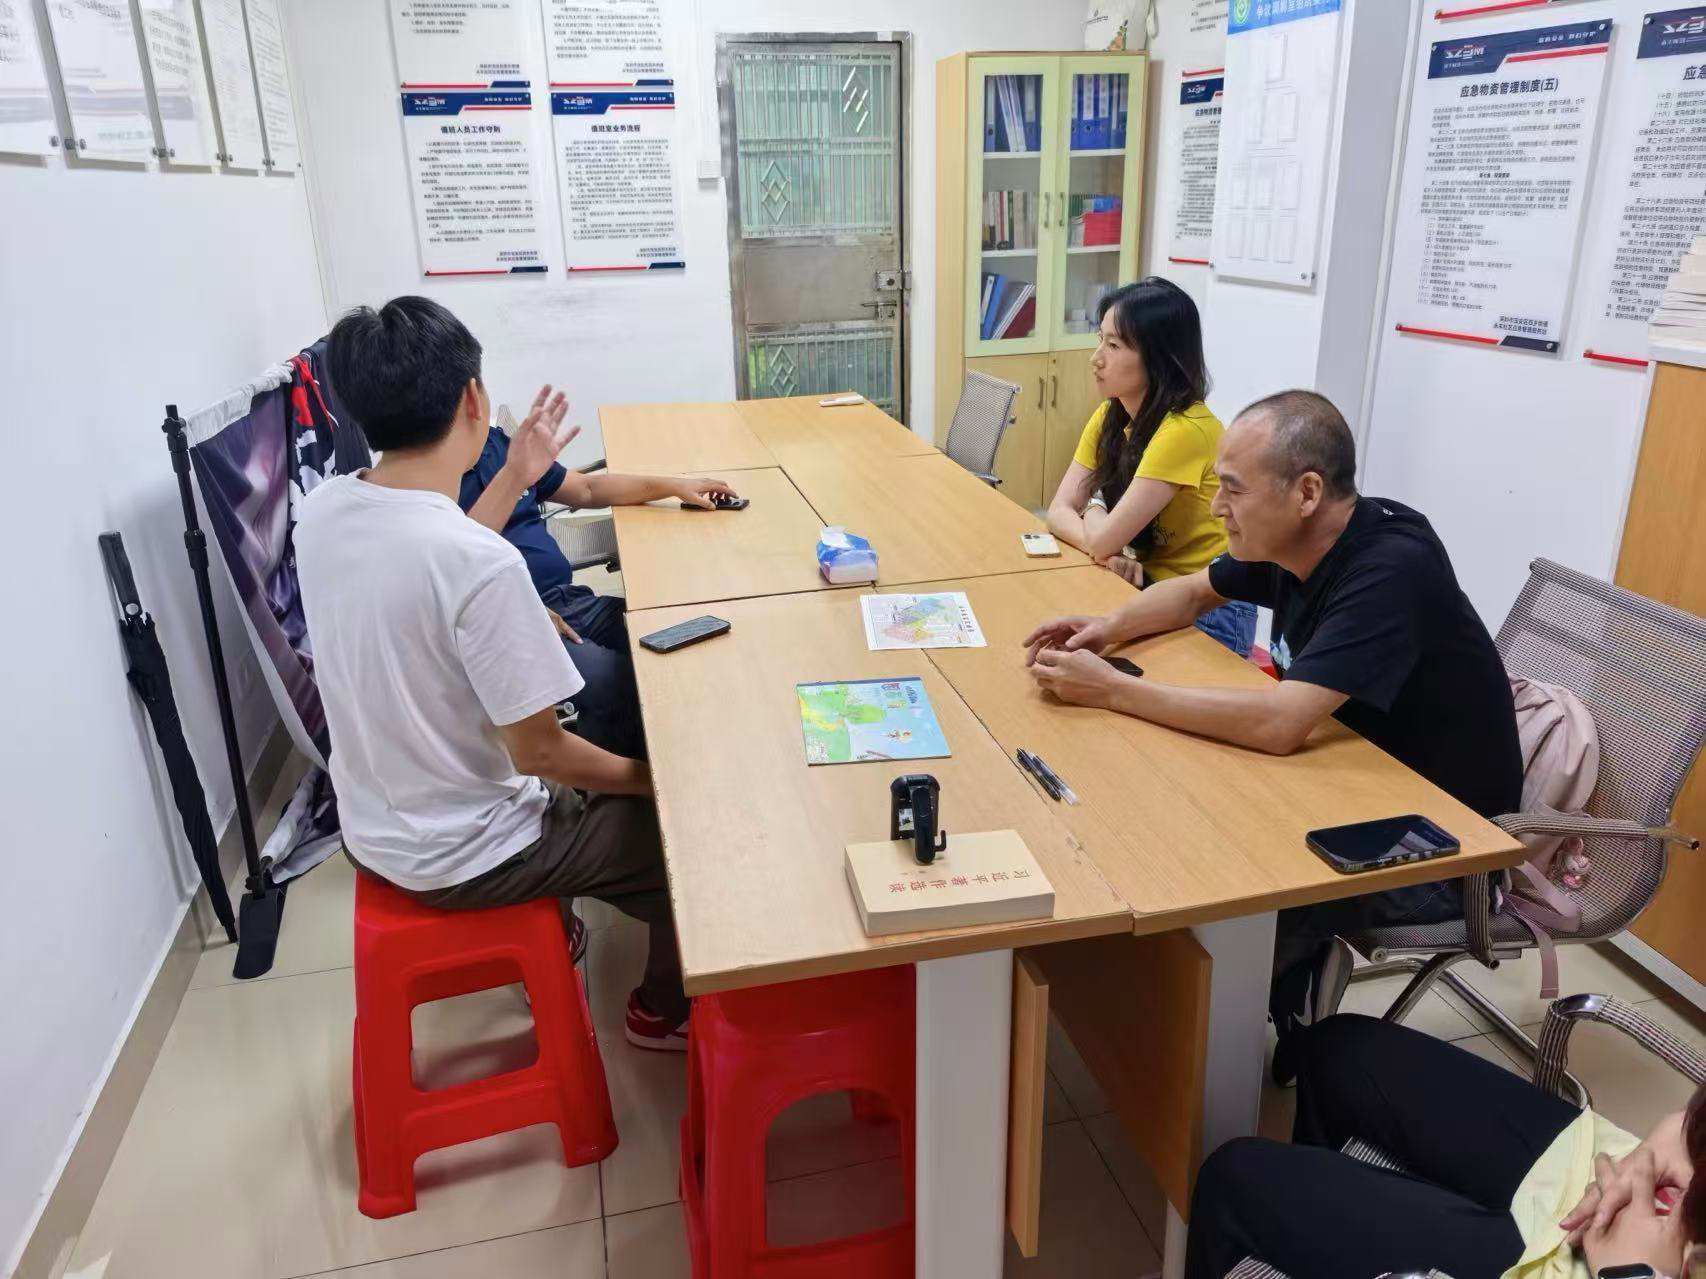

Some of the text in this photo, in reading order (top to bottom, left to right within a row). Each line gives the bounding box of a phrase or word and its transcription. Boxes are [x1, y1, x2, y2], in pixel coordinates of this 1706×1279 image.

[1460, 78, 1559, 97] 应急物资管理制度(五)
[440, 125, 501, 134] 值班人员工作守则
[591, 124, 641, 133] 值班室业务流程
[888, 869, 1031, 893] 习近平著作选读
